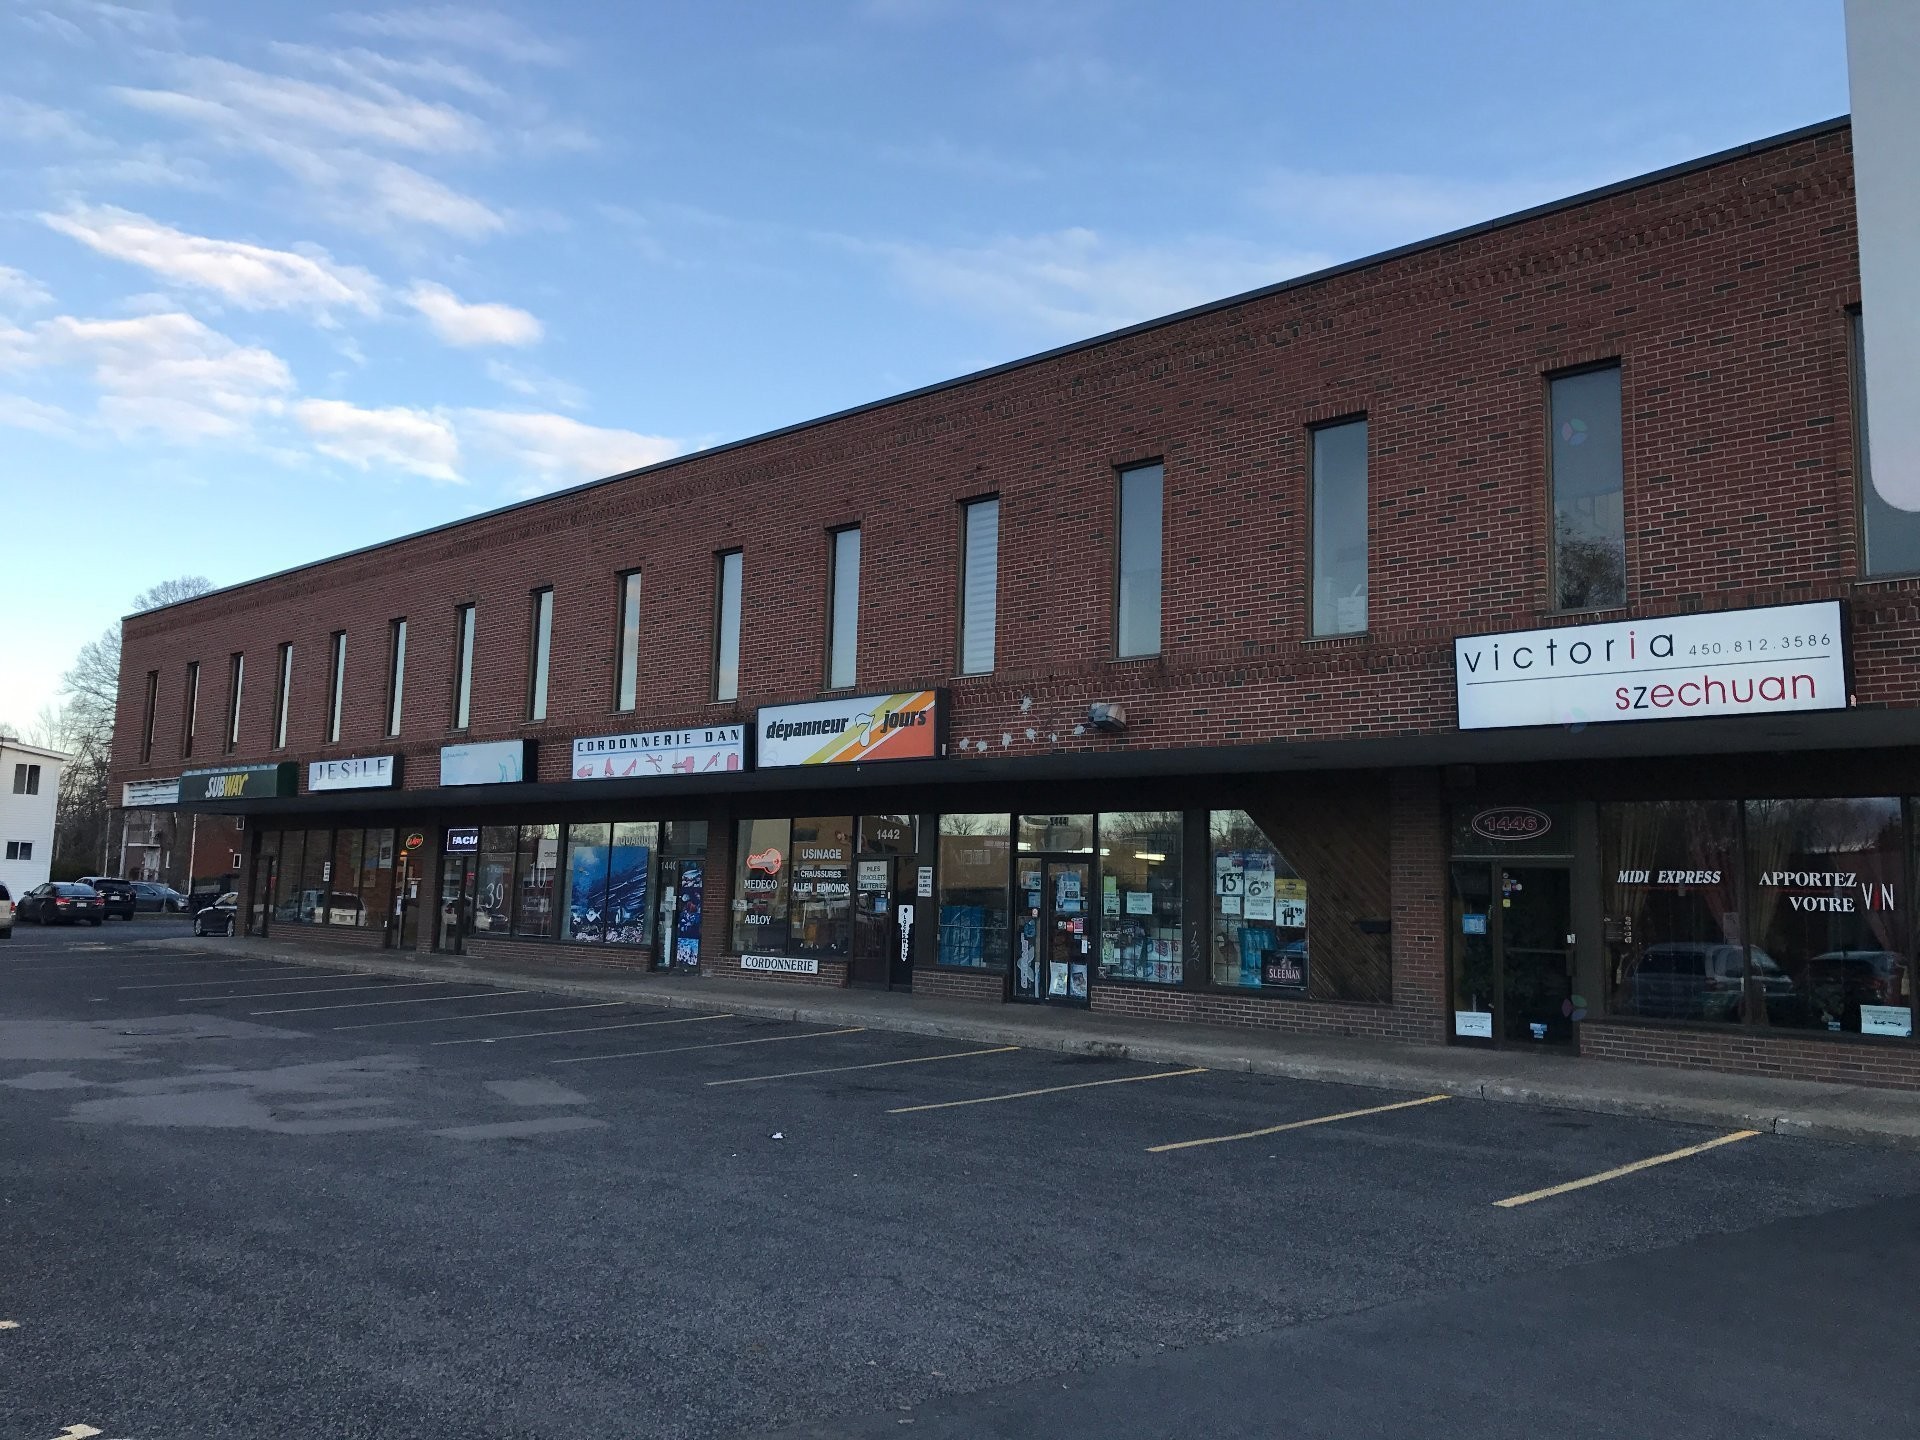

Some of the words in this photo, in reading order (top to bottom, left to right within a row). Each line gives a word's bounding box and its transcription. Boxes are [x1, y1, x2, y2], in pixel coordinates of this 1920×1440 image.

[1464, 631, 1674, 673] victoria
[1688, 633, 1831, 657] 450.812.3586
[1615, 674, 1816, 710] szechuan
[766, 717, 849, 741] dépanneur
[854, 712, 876, 747] 7
[880, 710, 927, 734] jours
[577, 733, 691, 752] CORDONNERIE
[704, 729, 740, 743] DAN
[205, 773, 249, 798] SUBWAY
[1484, 816, 1538, 831] 1446
[876, 829, 900, 840] 1442
[802, 848, 842, 860] USINAGE
[800, 870, 842, 878] CHAUSSURES
[860, 873, 886, 881] BRACELETS
[1617, 870, 1650, 884] MIDI
[1657, 870, 1722, 884] EXPRESS
[1758, 871, 1857, 888] APPORTEZ
[743, 879, 778, 890] MEDECO
[792, 883, 814, 893] ALLEN
[816, 882, 850, 893] EDMONDS
[860, 881, 886, 890] BATTERIES
[1790, 896, 1856, 912] VOTRE
[744, 914, 772, 925] ABLOY
[745, 957, 814, 972] CORDONNERIE
[1269, 967, 1300, 979] SLEEMAN
